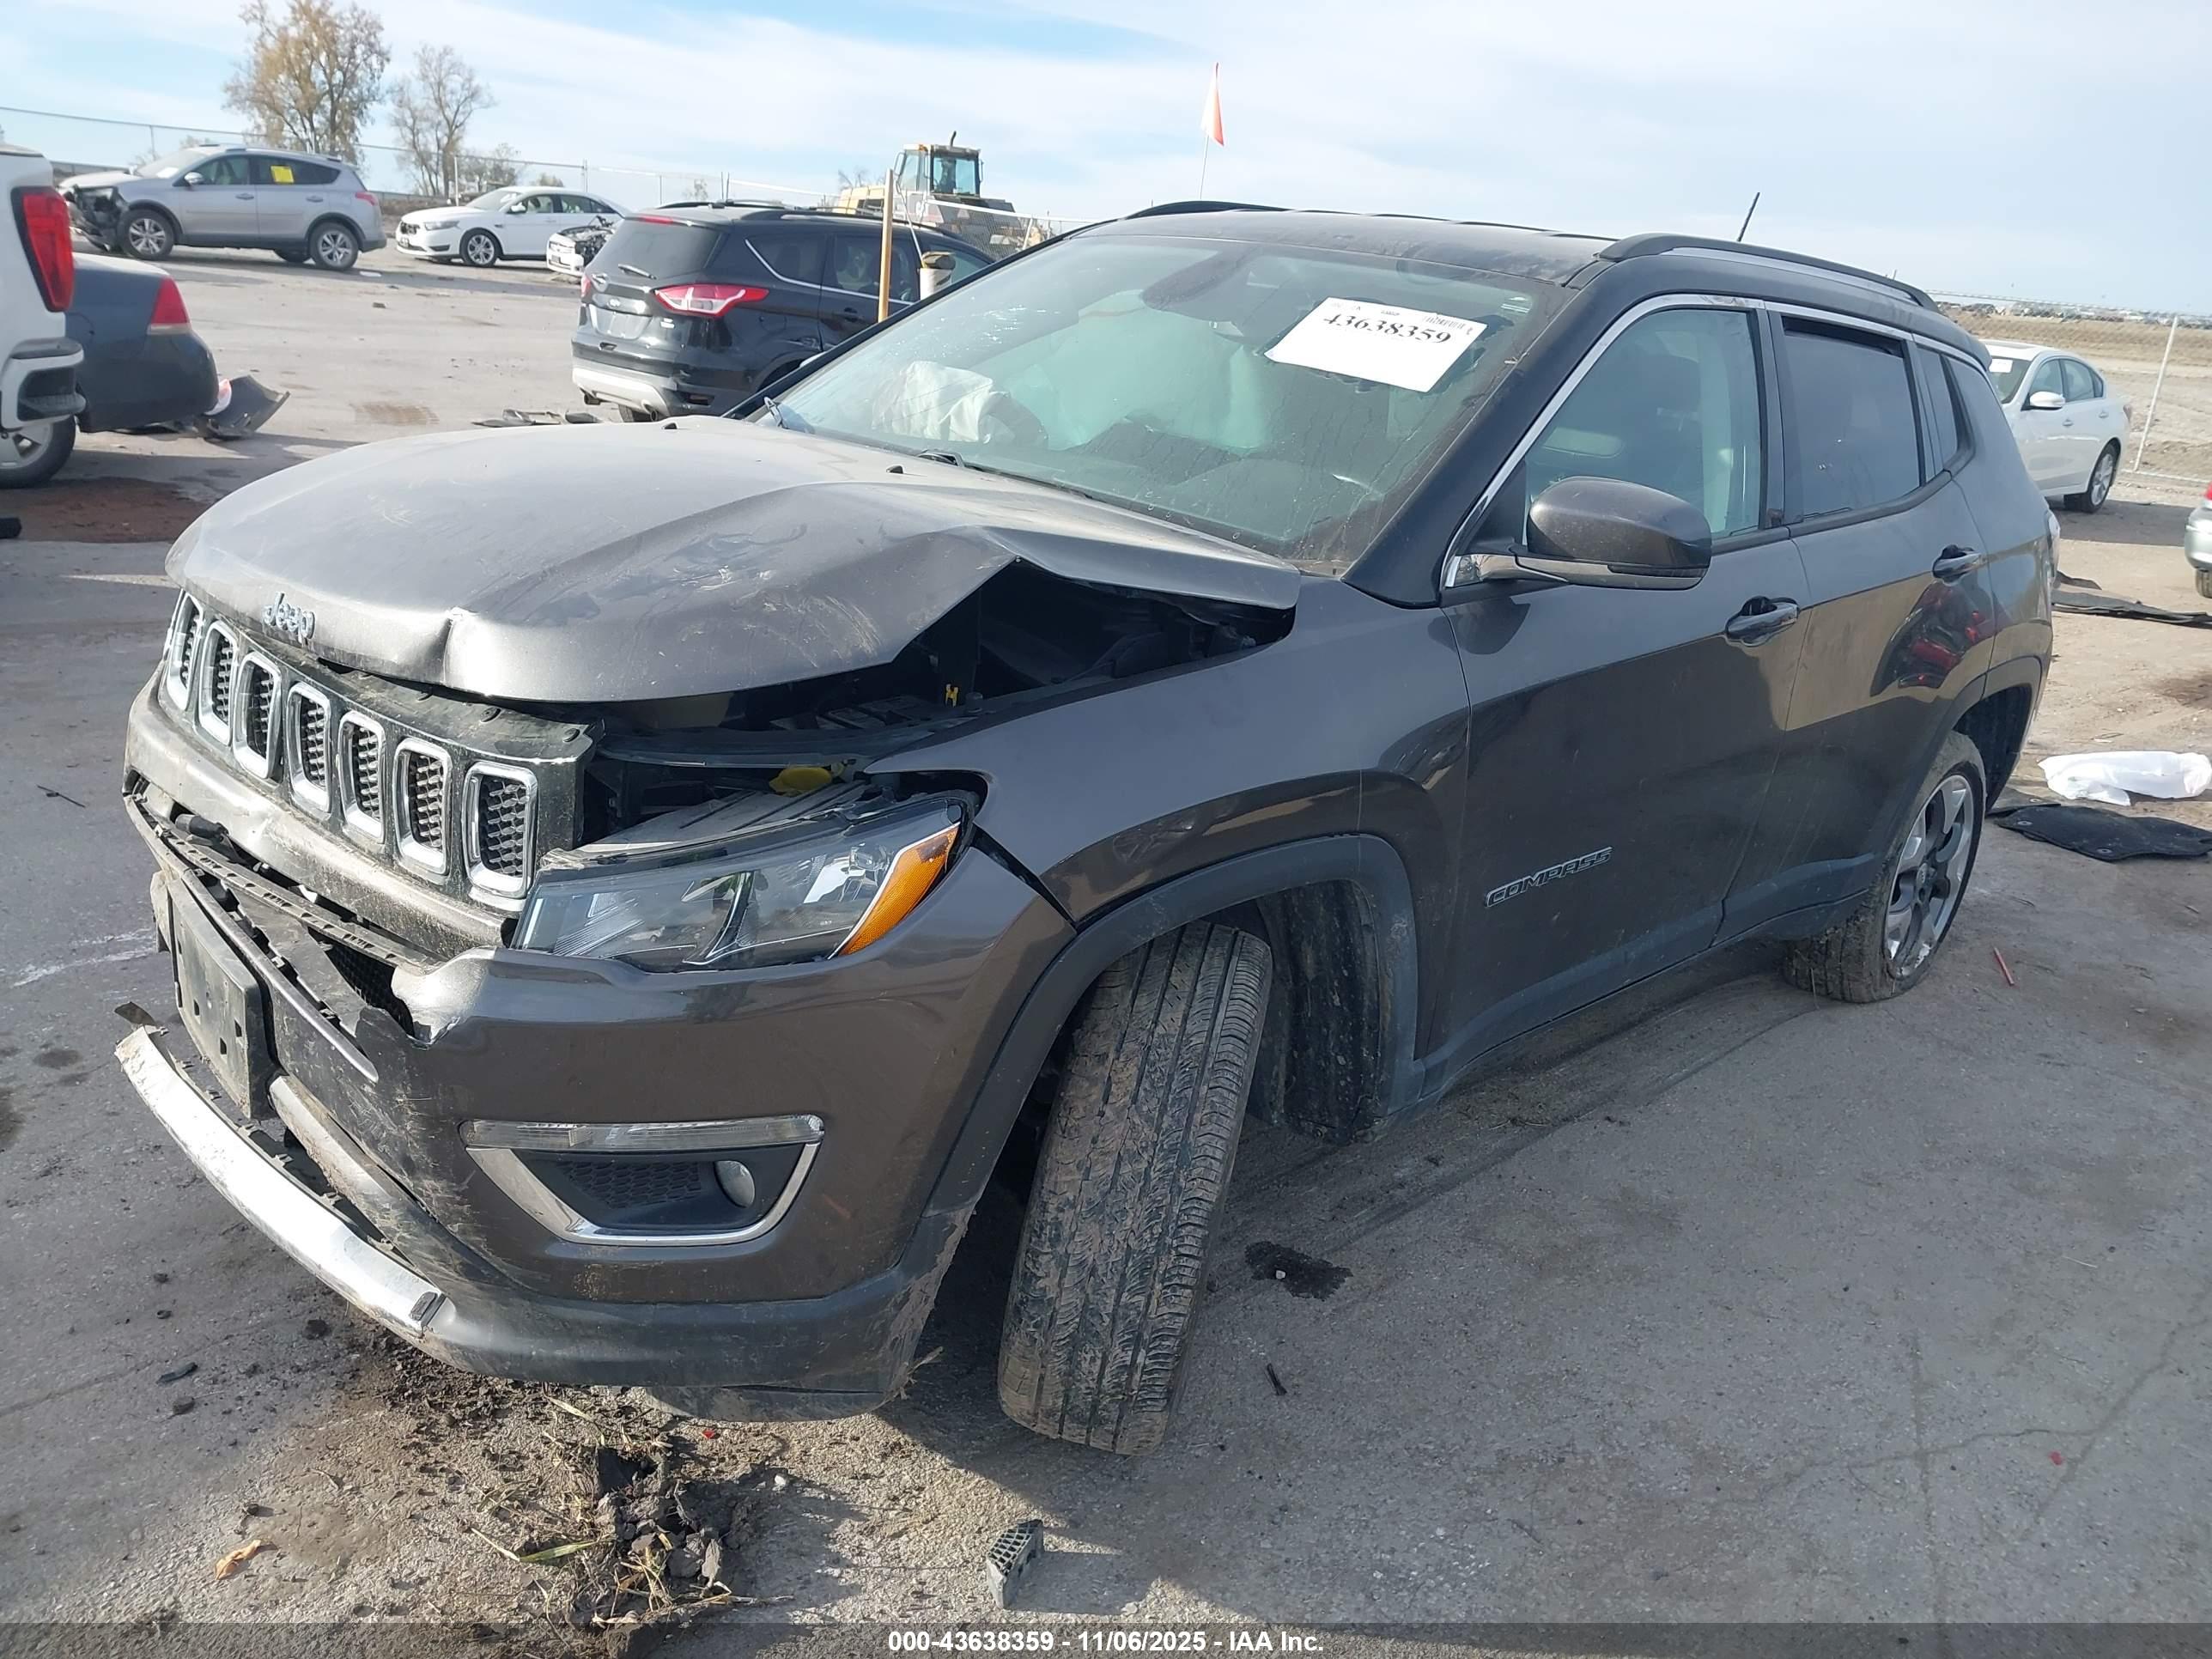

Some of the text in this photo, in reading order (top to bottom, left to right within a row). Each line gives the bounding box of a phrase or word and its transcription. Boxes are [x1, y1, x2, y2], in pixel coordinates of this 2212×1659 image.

[1322, 313, 1452, 343] 43638359
[264, 592, 315, 643] Jeep
[1485, 847, 1613, 907] COMPASS
